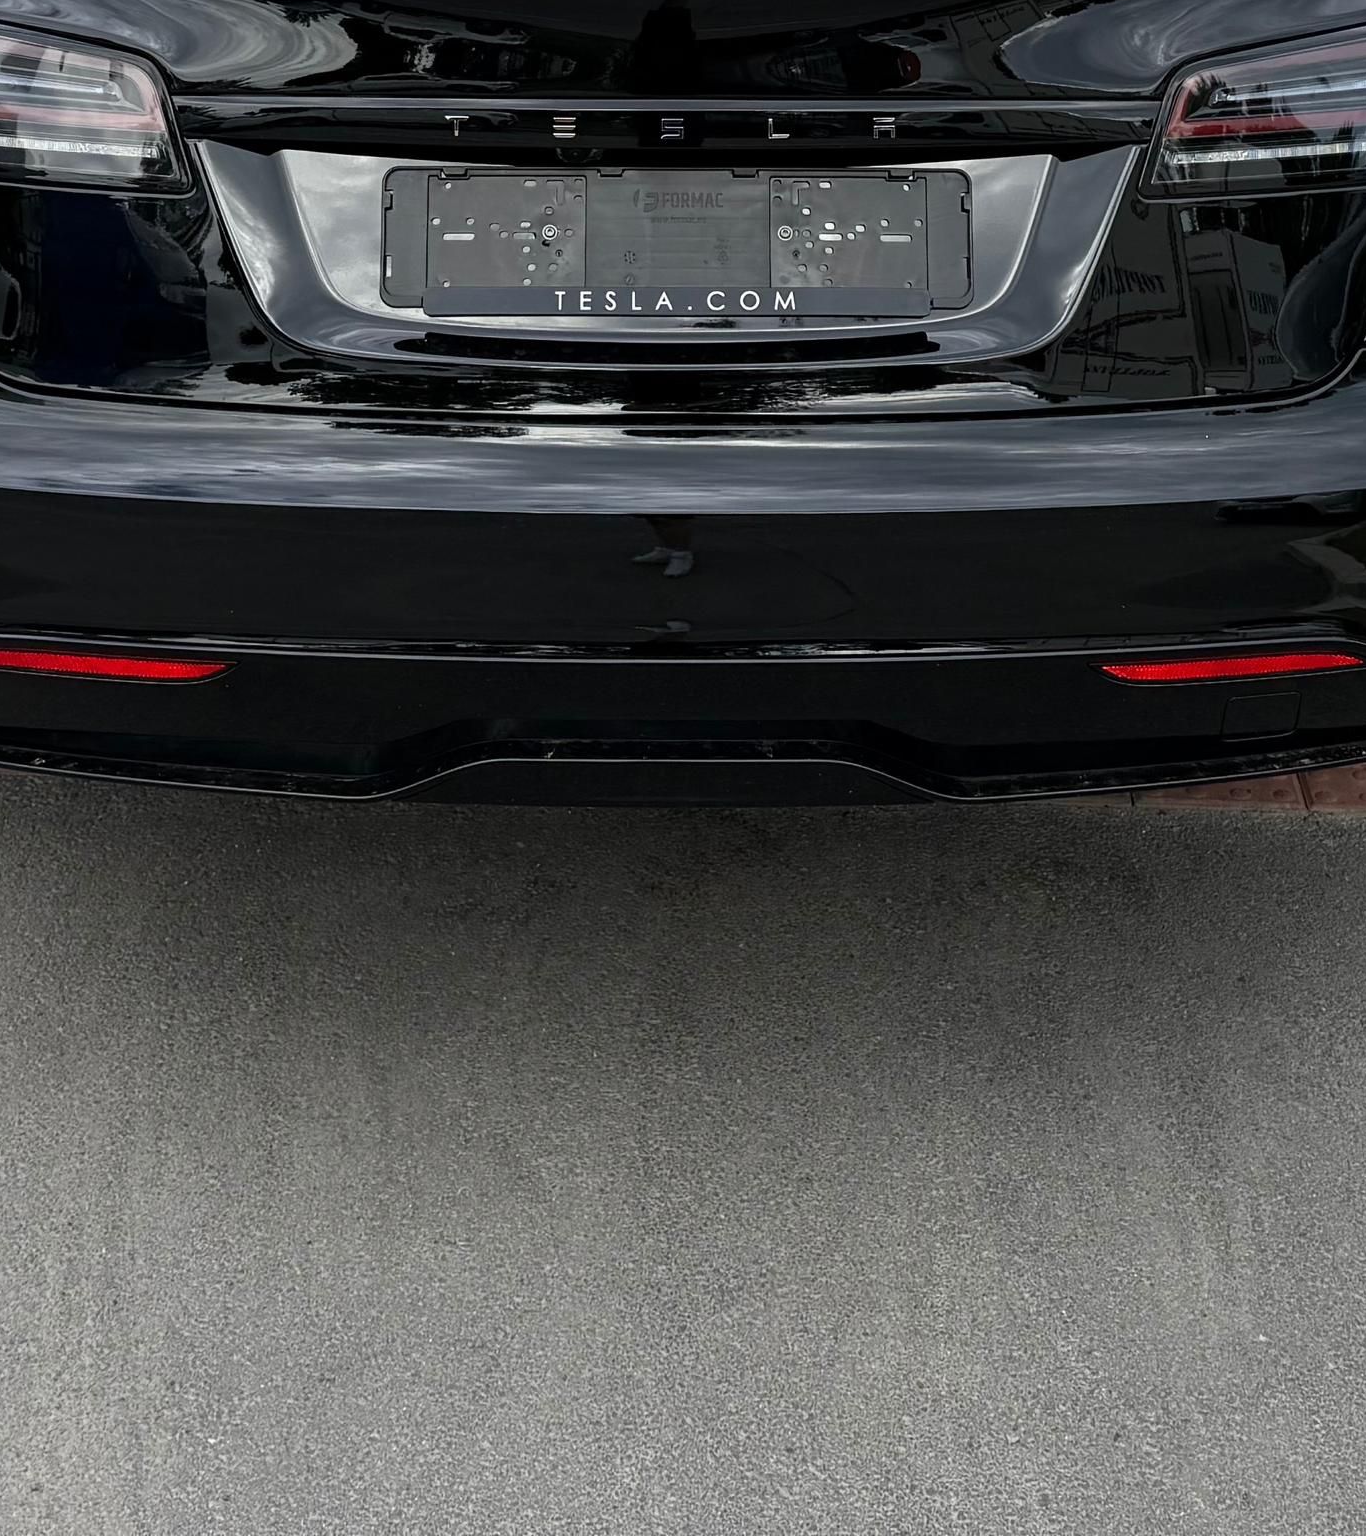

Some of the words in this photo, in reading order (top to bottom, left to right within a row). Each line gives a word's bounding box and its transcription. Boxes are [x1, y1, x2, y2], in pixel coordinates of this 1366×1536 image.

[444, 115, 896, 140] TESLA
[661, 192, 724, 208] FORMAC
[554, 290, 797, 312] TESLA.COM
